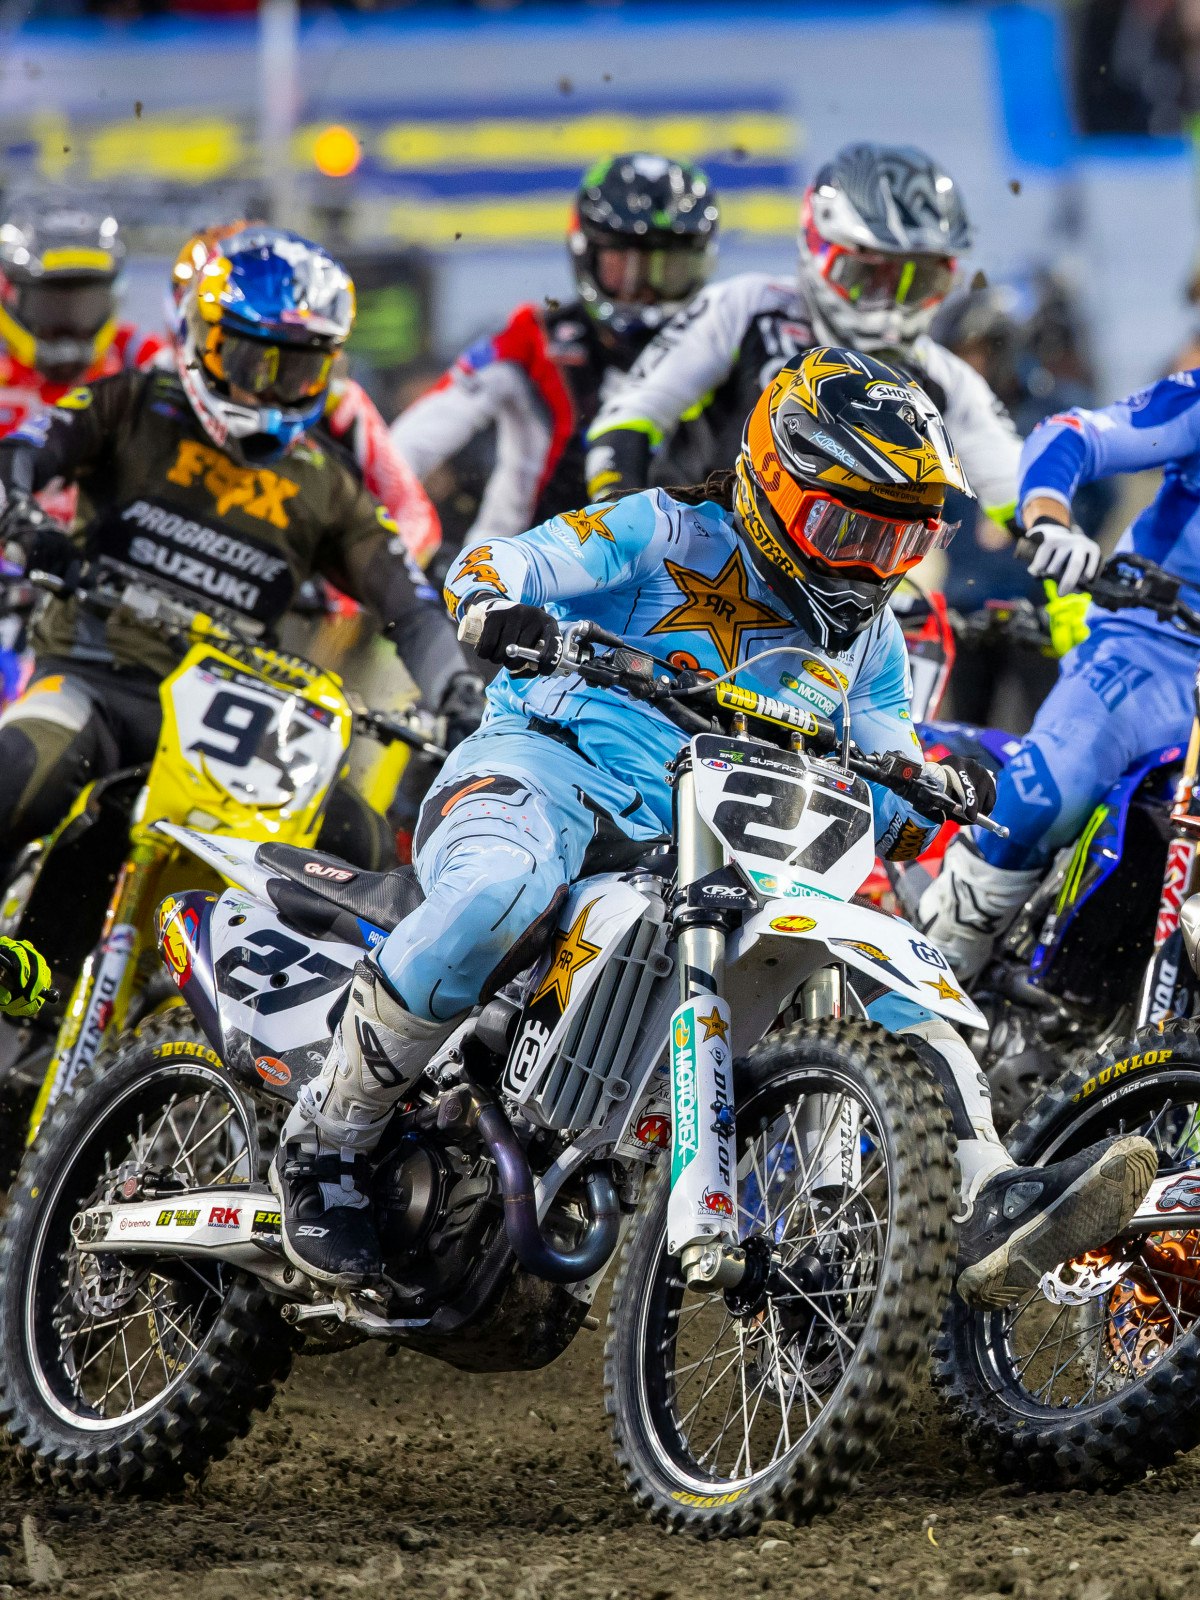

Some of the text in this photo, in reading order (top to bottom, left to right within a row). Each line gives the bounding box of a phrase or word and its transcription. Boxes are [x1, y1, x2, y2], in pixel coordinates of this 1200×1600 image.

[876, 387, 915, 402] SHOE
[167, 440, 299, 529] FOX
[122, 501, 289, 582] PROGRESSIVE
[128, 537, 261, 608] SUZUKI
[712, 771, 871, 875] 27
[305, 863, 352, 880] GUTS
[257, 1060, 289, 1082] Twin Air
[1082, 1049, 1173, 1098] DUNLOP
[675, 1048, 697, 1155] MOTOREX
[127, 1218, 151, 1229] brembo
[208, 1206, 242, 1224] RK
